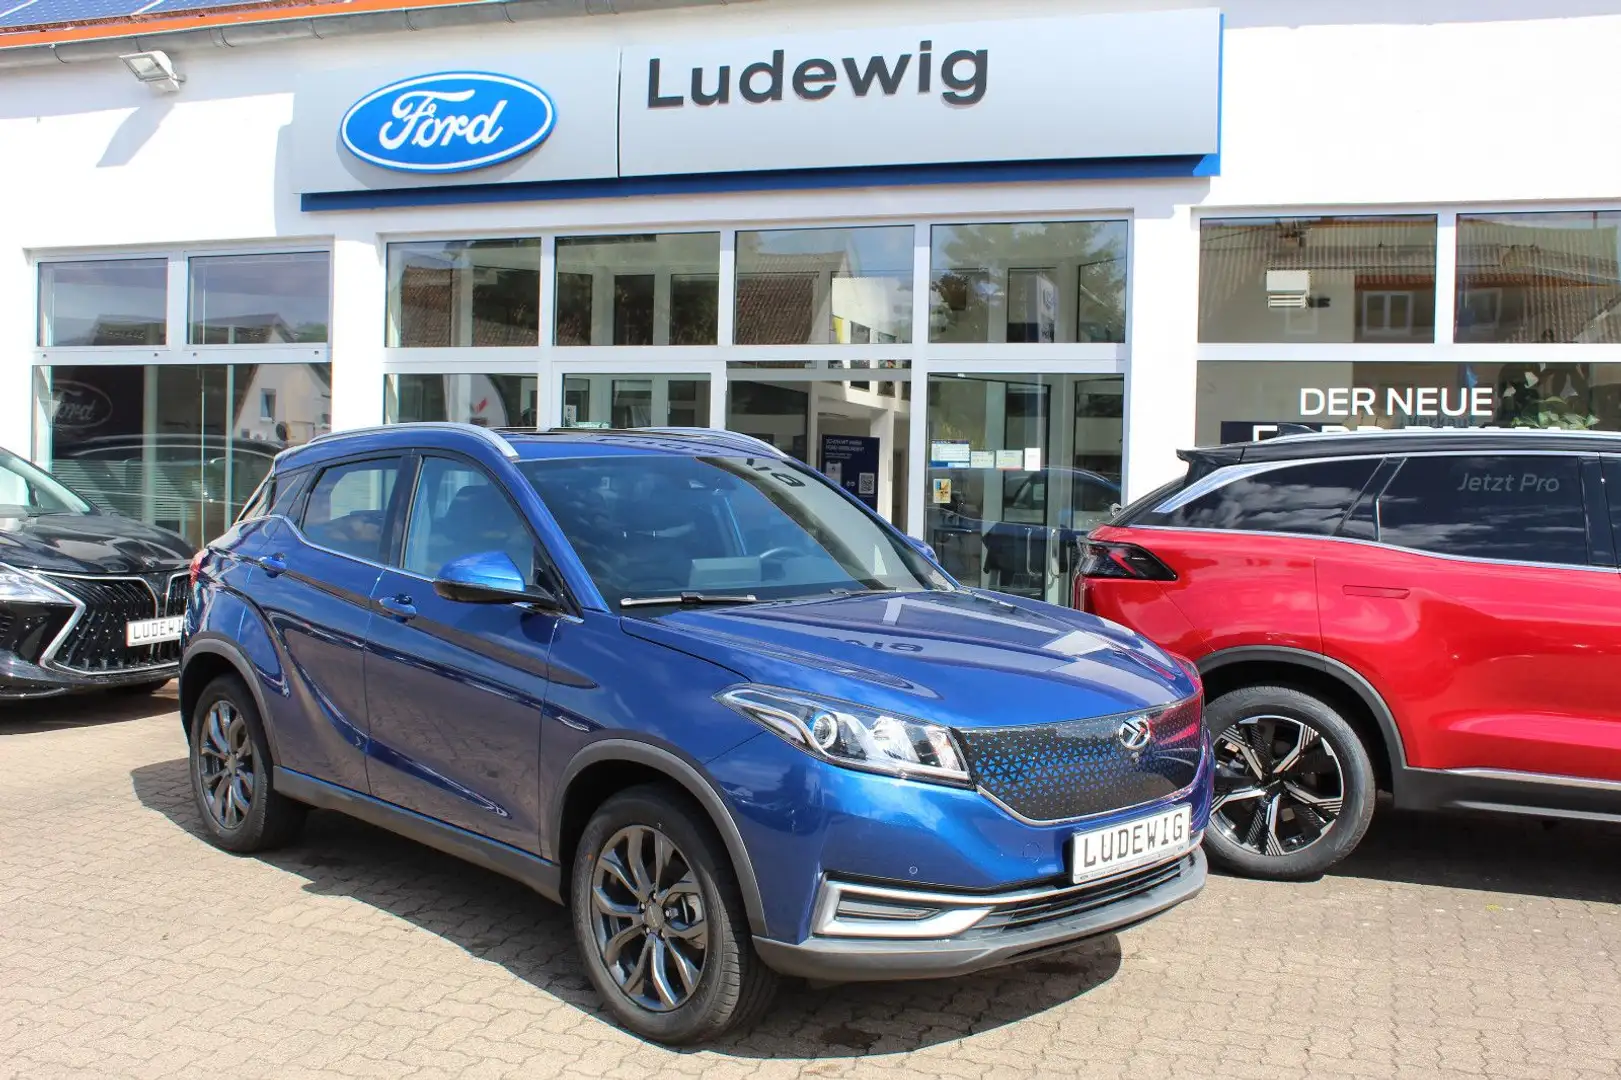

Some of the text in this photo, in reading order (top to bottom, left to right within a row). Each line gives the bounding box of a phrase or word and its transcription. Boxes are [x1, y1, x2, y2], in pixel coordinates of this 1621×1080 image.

[648, 39, 988, 107] Ludewig
[378, 88, 508, 150] Ford
[1300, 387, 1493, 416] DER NEUE
[1457, 473, 1560, 492] Jetzt Pro
[133, 619, 183, 639] LUDEWI
[1083, 812, 1183, 868] LUDEWIG
